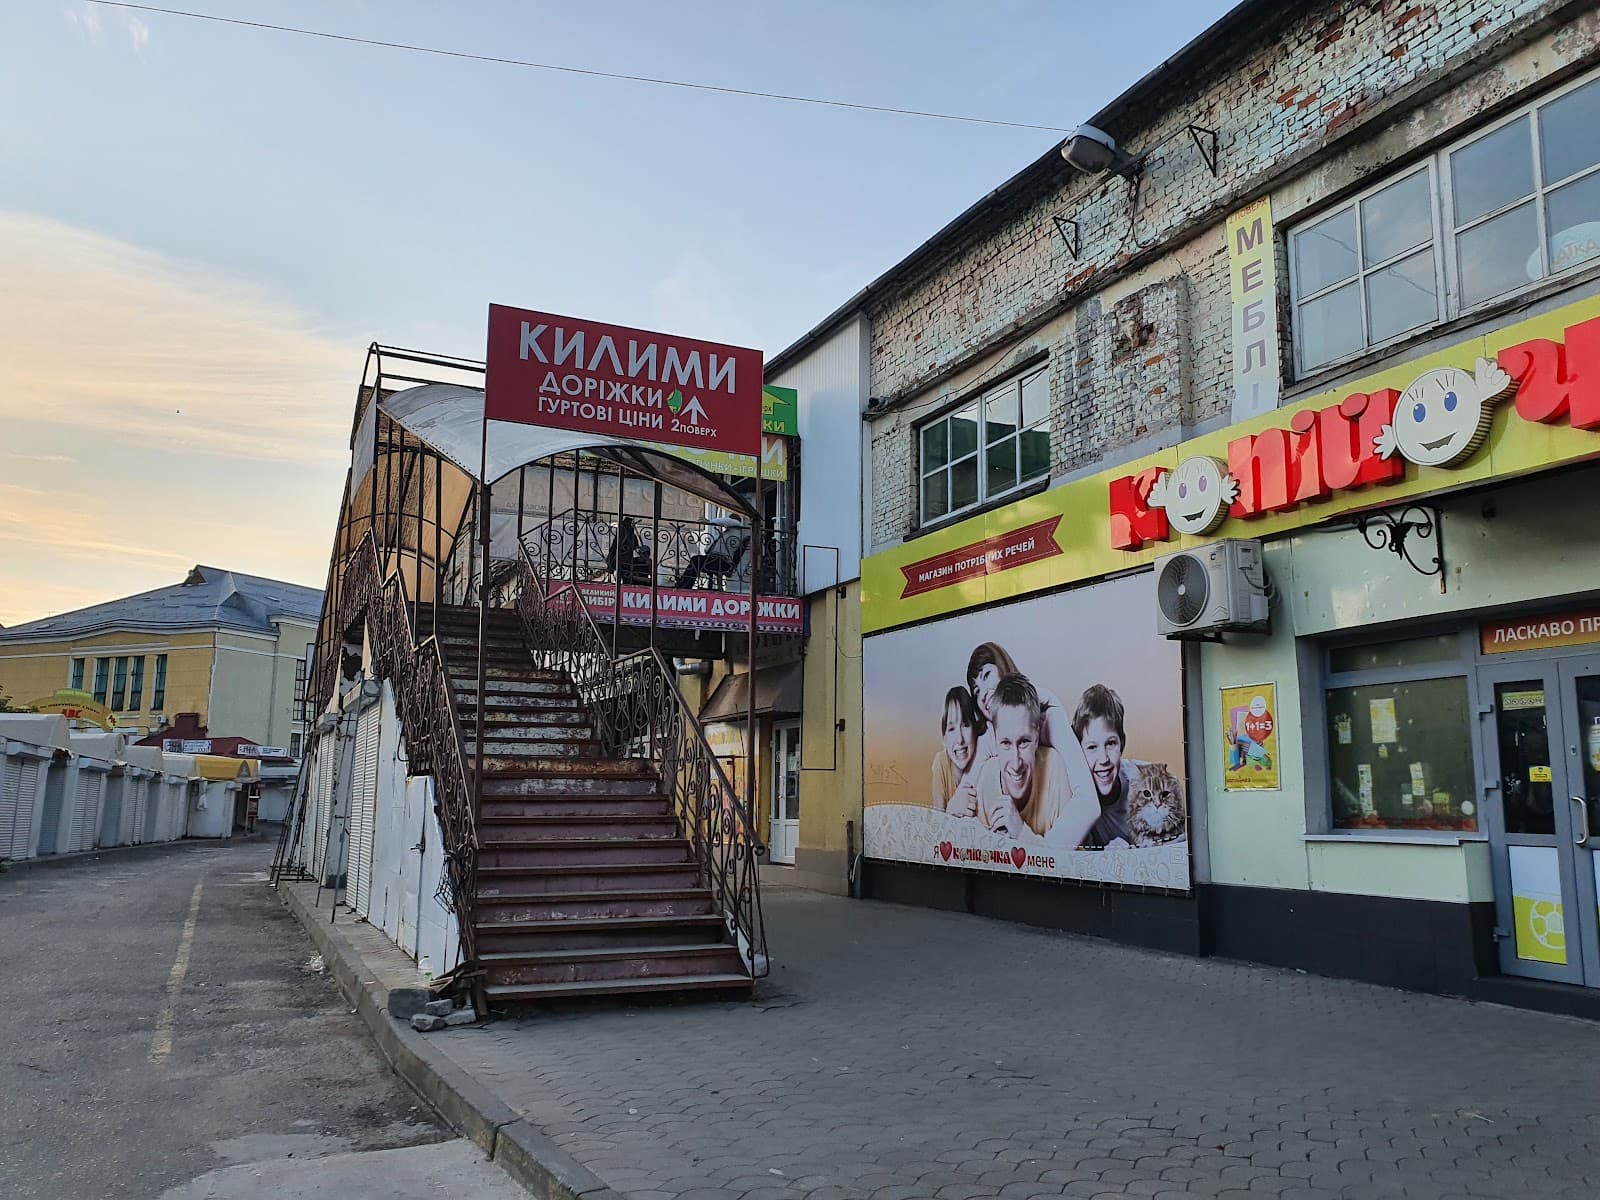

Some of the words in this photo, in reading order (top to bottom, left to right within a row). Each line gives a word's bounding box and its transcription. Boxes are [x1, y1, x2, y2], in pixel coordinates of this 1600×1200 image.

[1236, 216, 1267, 410] МЕБЛІ
[519, 320, 737, 395] КИЛИМИ
[538, 371, 663, 410] ДОРІЖКИ
[537, 396, 613, 422] ГУРТОВІ
[618, 407, 664, 430] ЦІНИ
[918, 565, 953, 583] МАГАЗИН
[954, 549, 1004, 573] ПОТРІБНИХ
[1004, 536, 1036, 558] РЕЧЕЙ
[581, 588, 615, 597] ВЕЛИКИЙ
[710, 598, 800, 620] ДОРЖКИ
[1493, 619, 1575, 644] ЛАСКАВО
[1245, 720, 1273, 732] 1+1=3
[1027, 855, 1055, 869] мене
